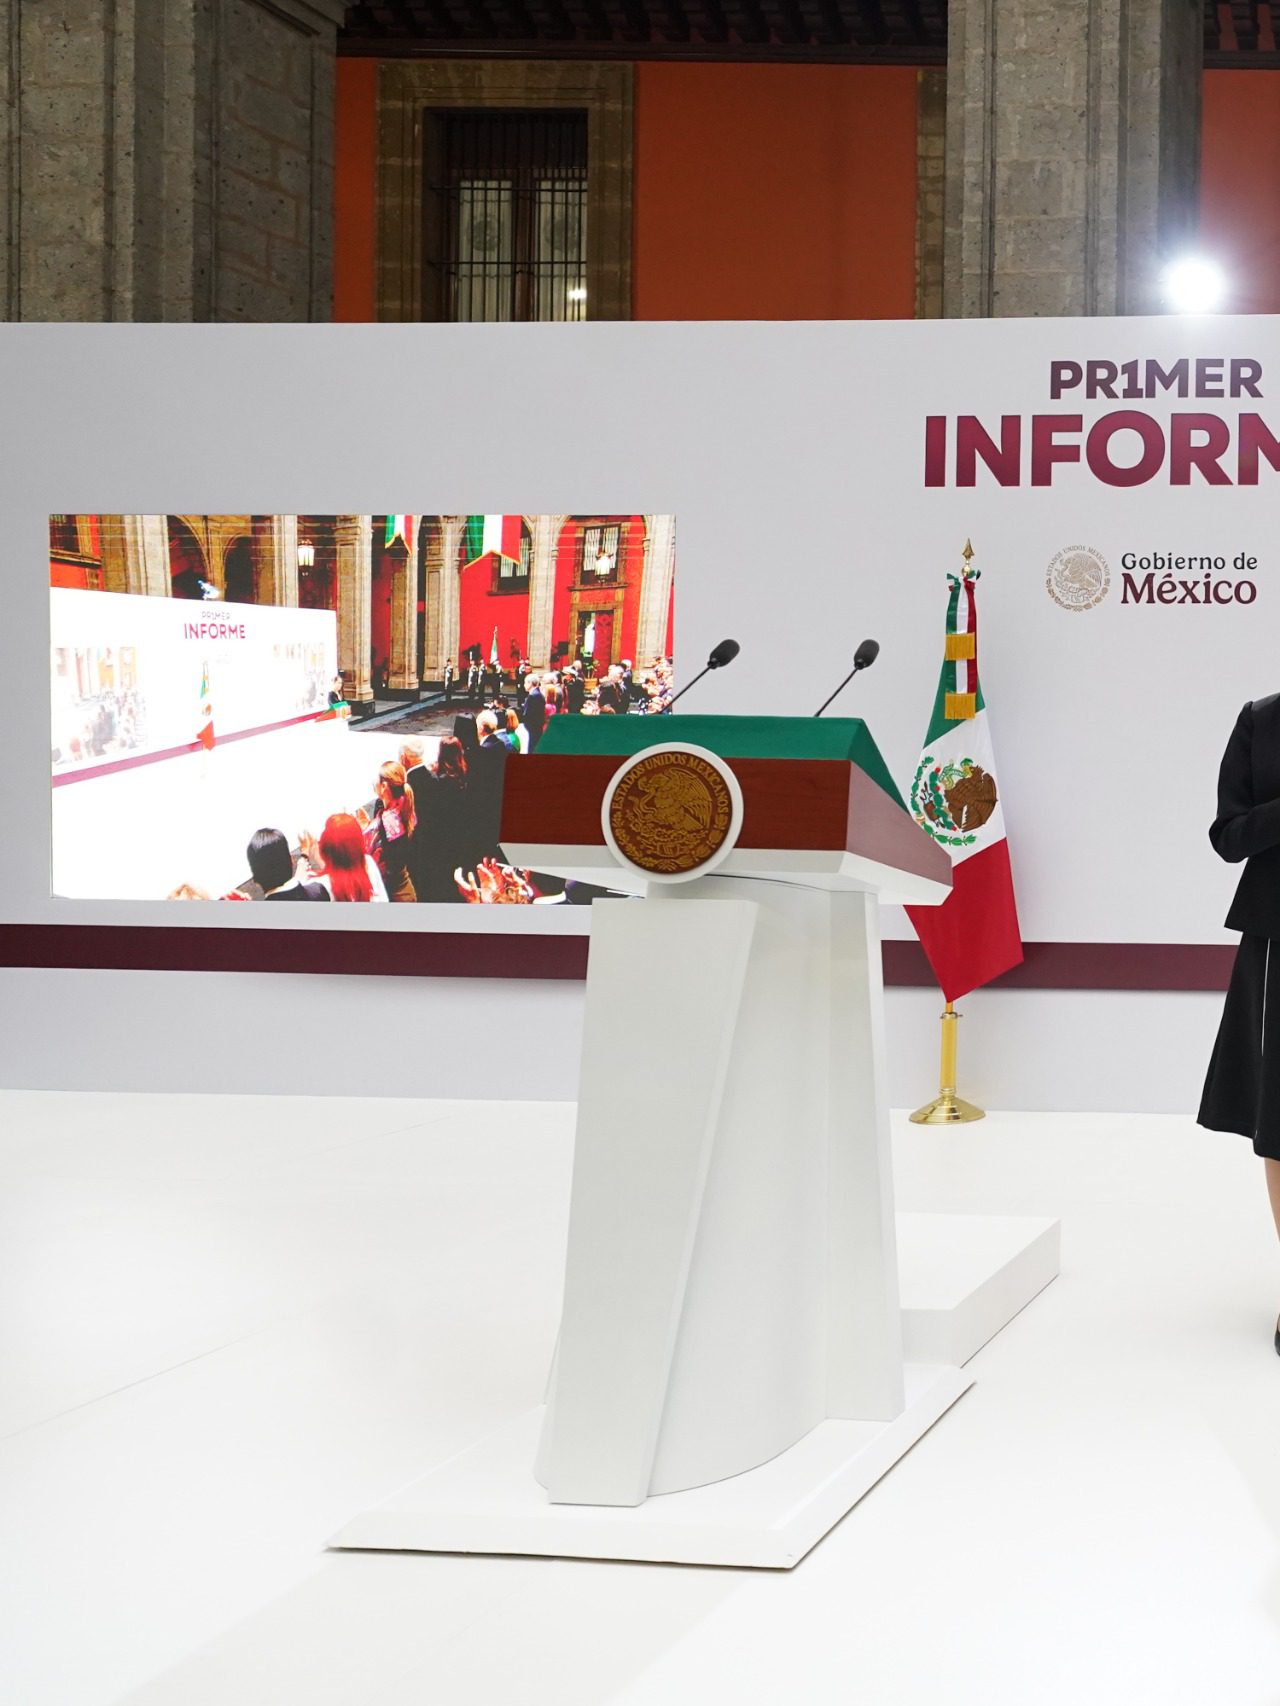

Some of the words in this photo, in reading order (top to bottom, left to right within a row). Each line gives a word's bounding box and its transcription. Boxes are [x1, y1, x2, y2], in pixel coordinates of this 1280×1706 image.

[1050, 358, 1263, 400] PR1MER
[1121, 552, 1226, 570] Gobierno
[1233, 552, 1258, 570] de
[1121, 572, 1257, 605] México
[184, 623, 246, 640] INFORME
[612, 763, 647, 809] ESTADOS
[645, 753, 687, 770] UNIDOS
[687, 756, 729, 814] MEXICANOS
